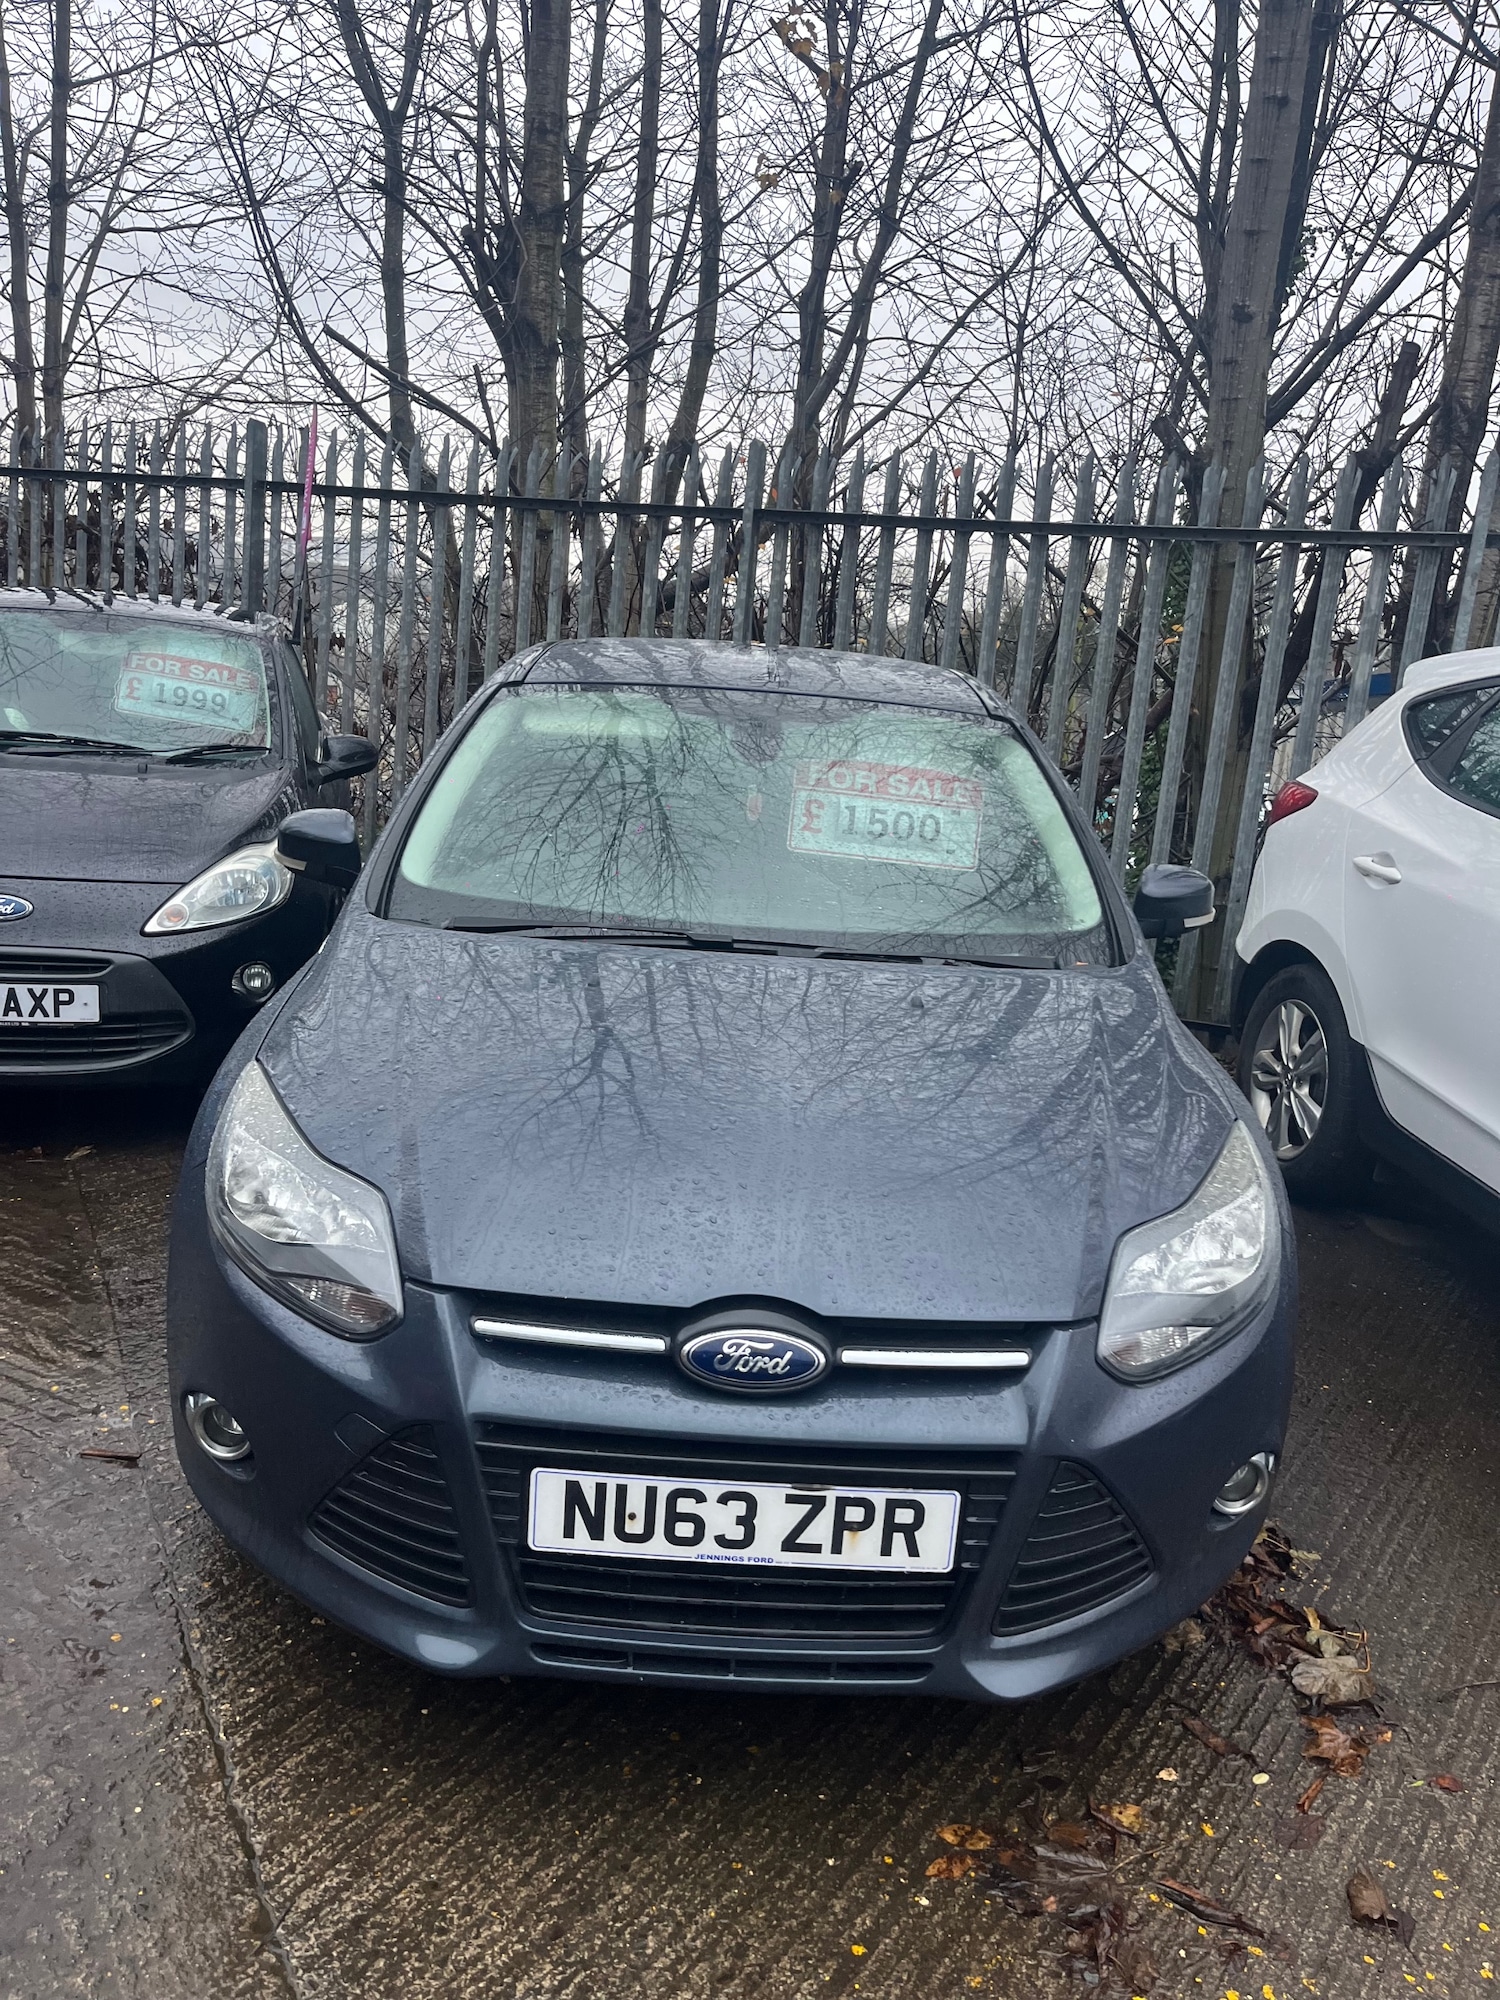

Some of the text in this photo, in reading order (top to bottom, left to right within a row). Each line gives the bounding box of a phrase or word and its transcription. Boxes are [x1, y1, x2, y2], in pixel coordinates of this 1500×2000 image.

[130, 654, 252, 688] FOR SALE
[125, 677, 227, 713] £ 1999
[807, 764, 975, 803] FOR SALE
[800, 799, 942, 844] £ 1500
[2, 987, 75, 1018] AXP
[713, 1338, 794, 1375] Ford
[562, 1479, 926, 1558] NU63 ZPR
[694, 1553, 745, 1563] JENNINGS
[747, 1556, 774, 1564] FORD
